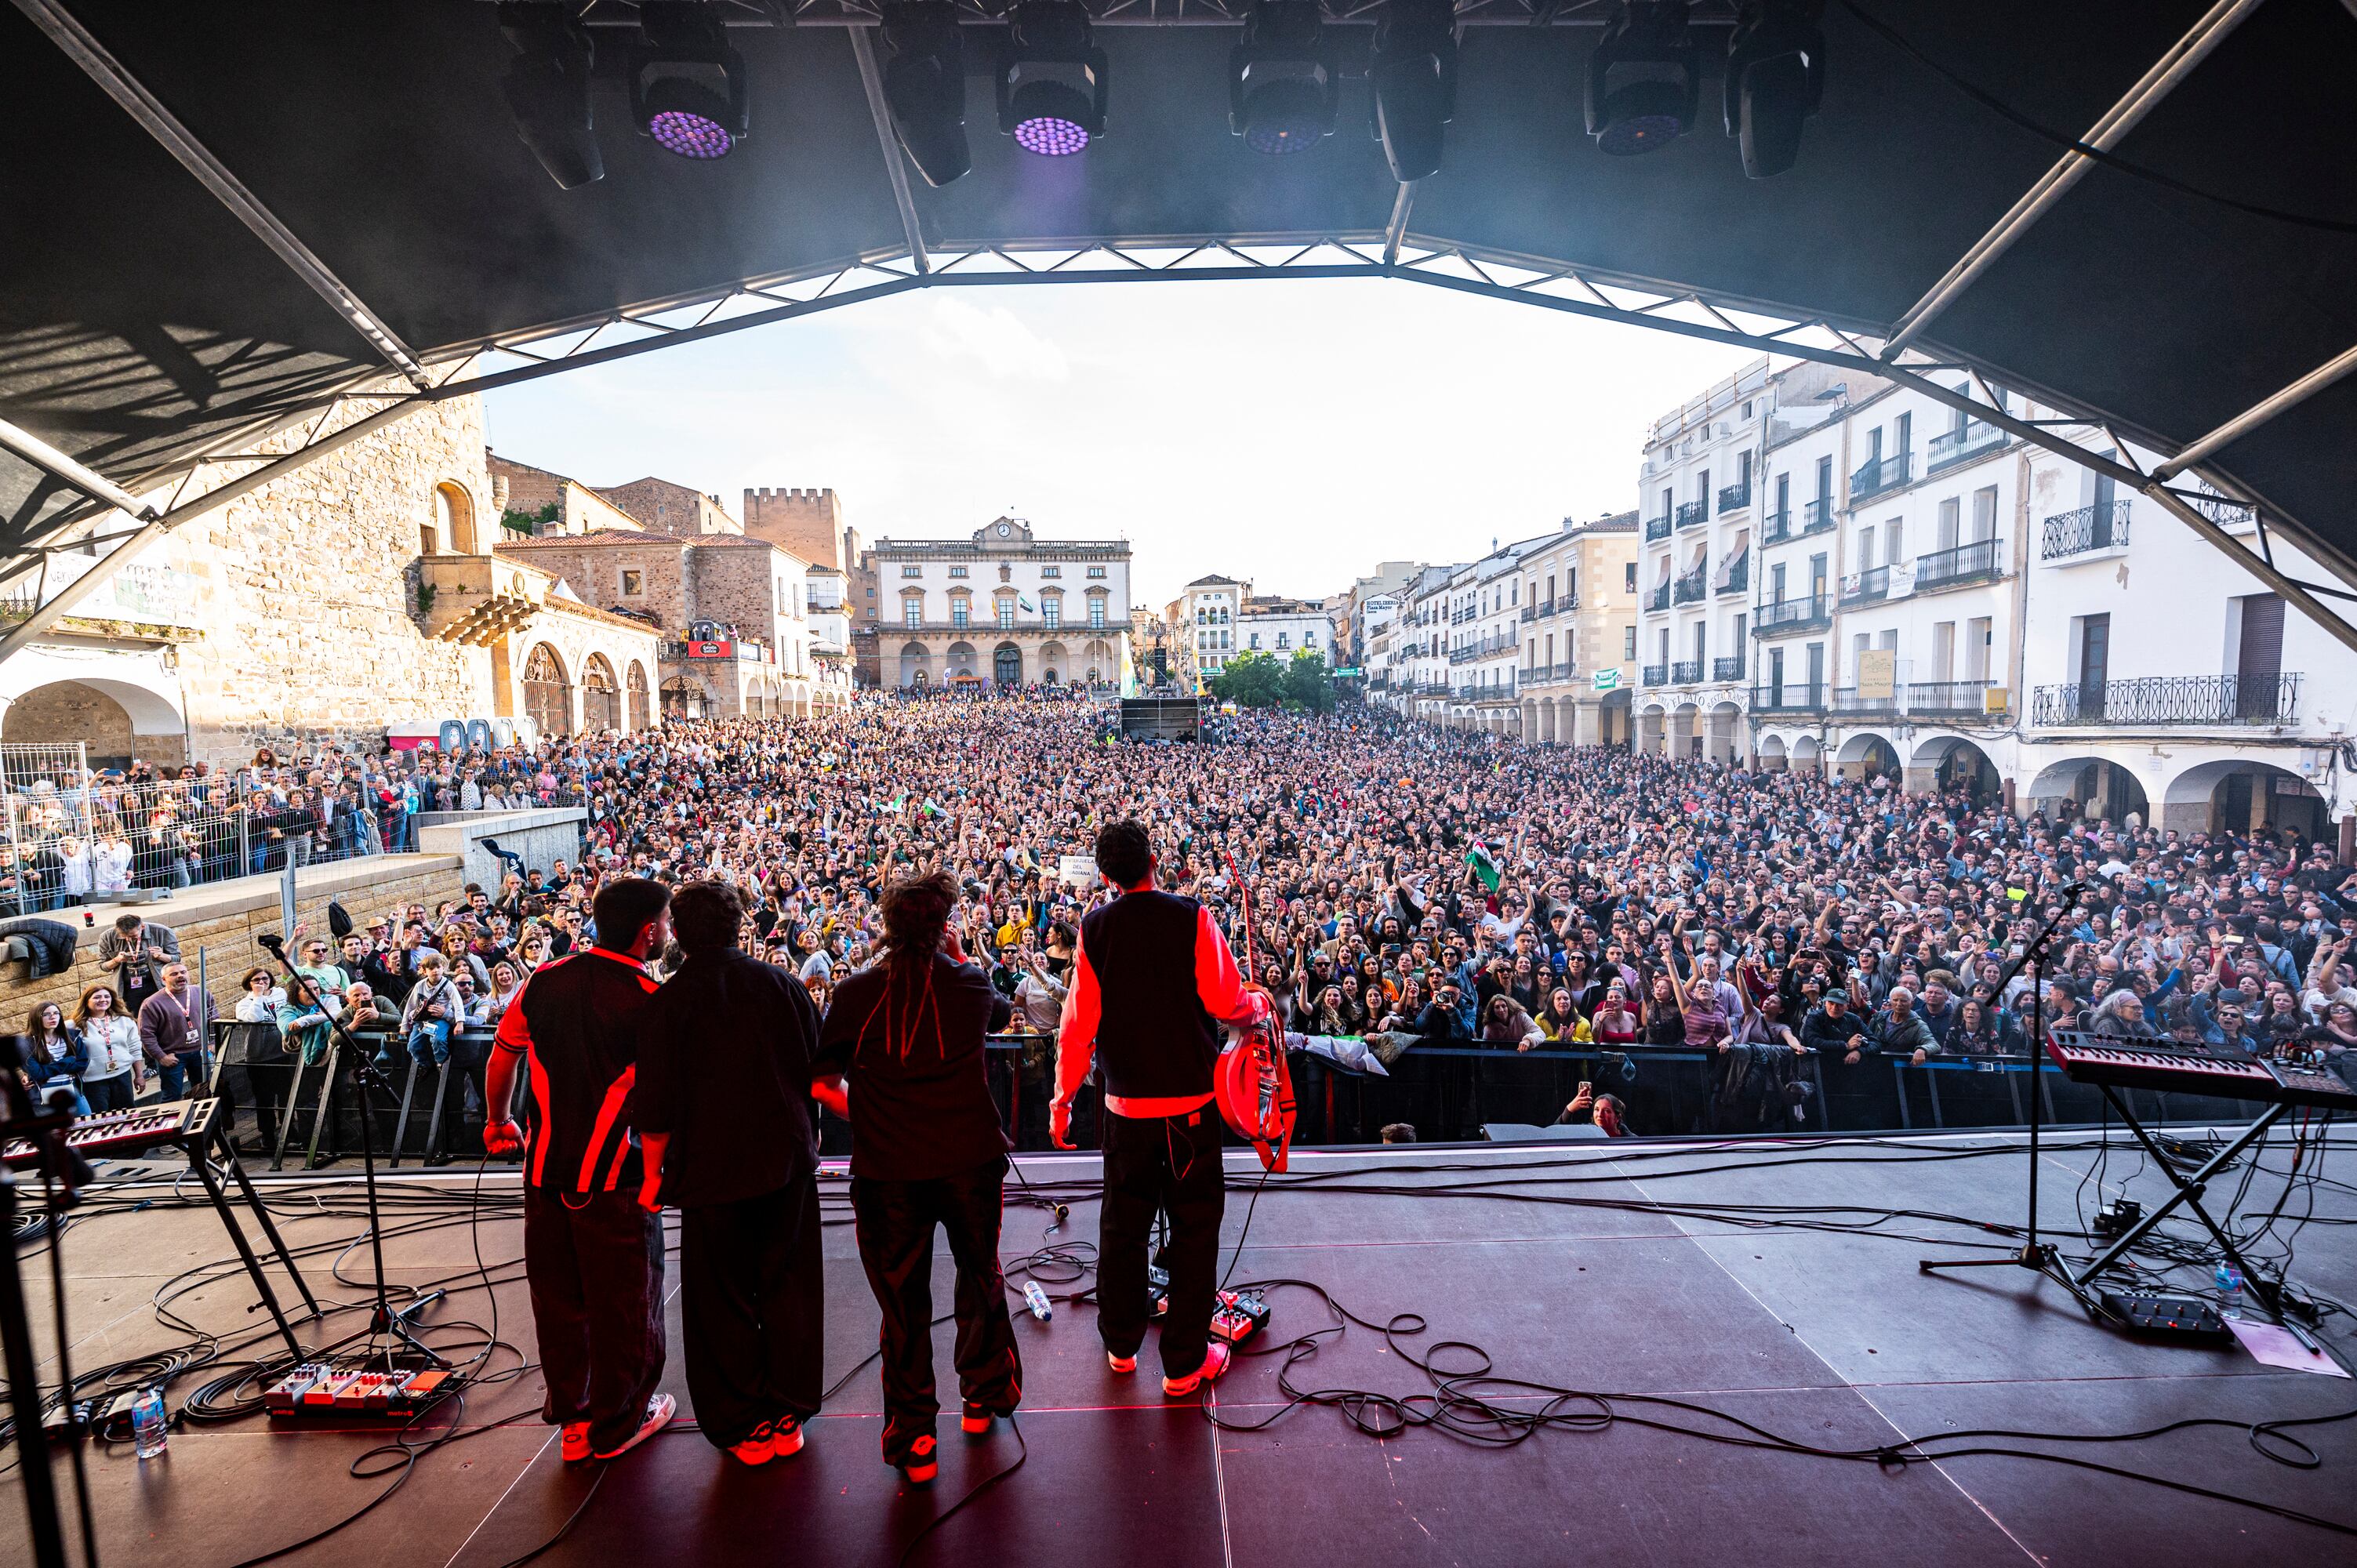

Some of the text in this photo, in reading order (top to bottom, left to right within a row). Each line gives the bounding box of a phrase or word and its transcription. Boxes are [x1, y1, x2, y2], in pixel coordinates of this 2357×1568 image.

[1640, 695, 1670, 710] CERVCERIA
[1672, 693, 1705, 708] EL PATO
